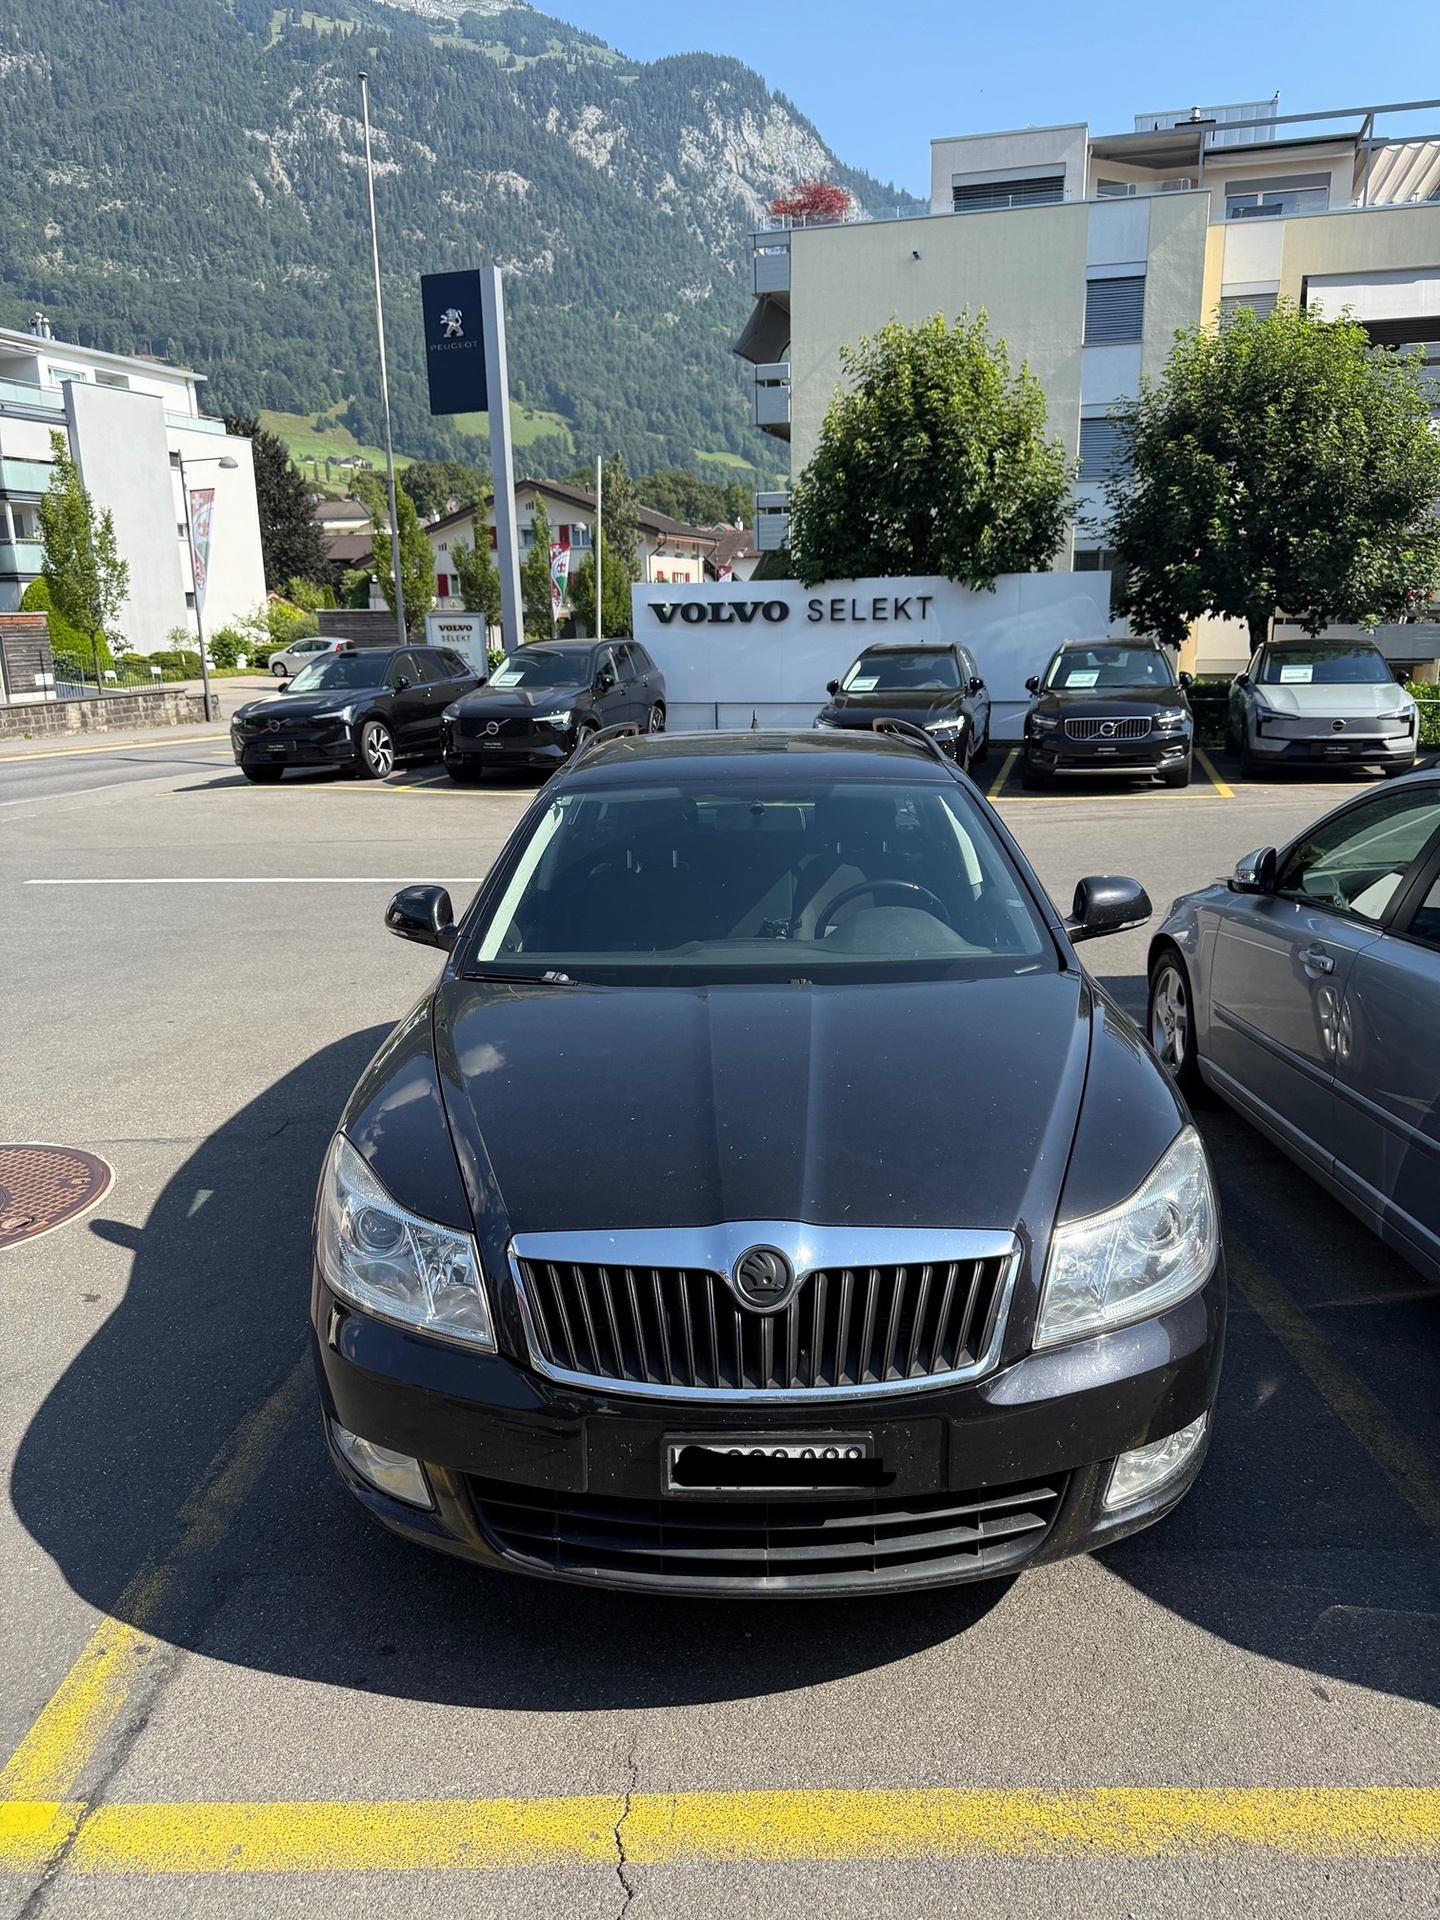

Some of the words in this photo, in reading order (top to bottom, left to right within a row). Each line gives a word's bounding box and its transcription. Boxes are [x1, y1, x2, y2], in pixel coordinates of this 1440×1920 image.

[430, 341, 478, 351] PEUGEOT
[648, 600, 790, 624] VOLVO
[807, 596, 933, 622] SELEKT
